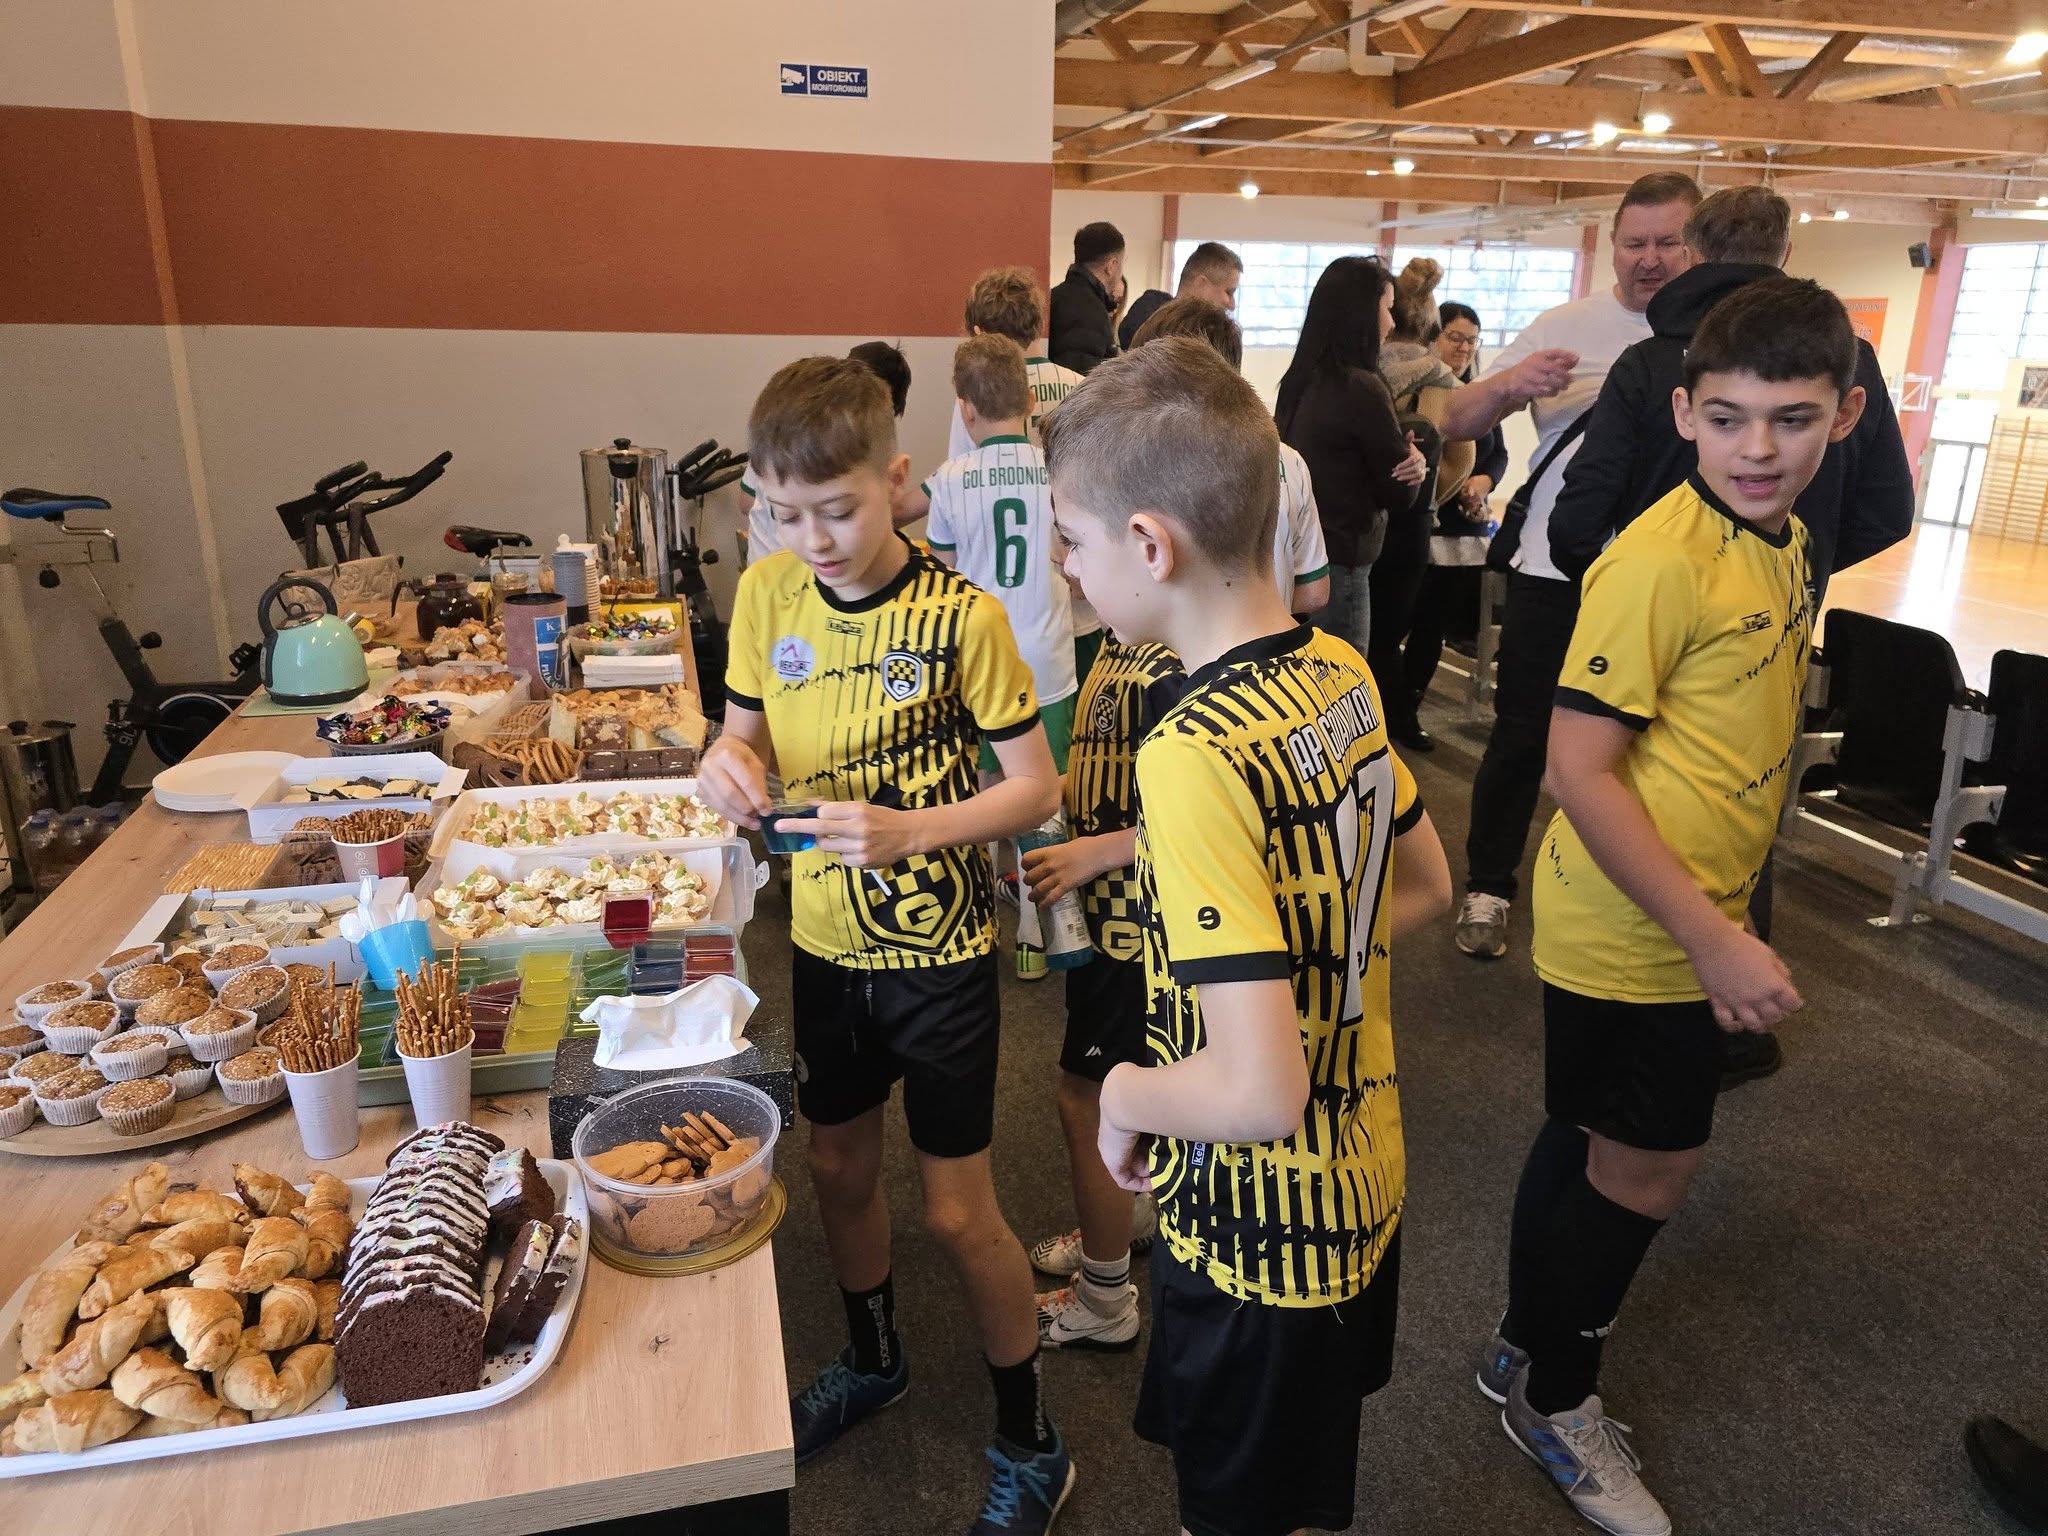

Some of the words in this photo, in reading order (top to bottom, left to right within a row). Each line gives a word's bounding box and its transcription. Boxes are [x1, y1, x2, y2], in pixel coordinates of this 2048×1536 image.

[811, 83, 867, 93] MONITOROWANY
[817, 69, 861, 83] OBIEKT
[962, 469, 986, 490] GOL
[988, 465, 1051, 487] BRODNIC
[993, 497, 1027, 588] 6
[1287, 722, 1325, 783] AP
[894, 892, 945, 935] G
[1102, 920, 1142, 961] G
